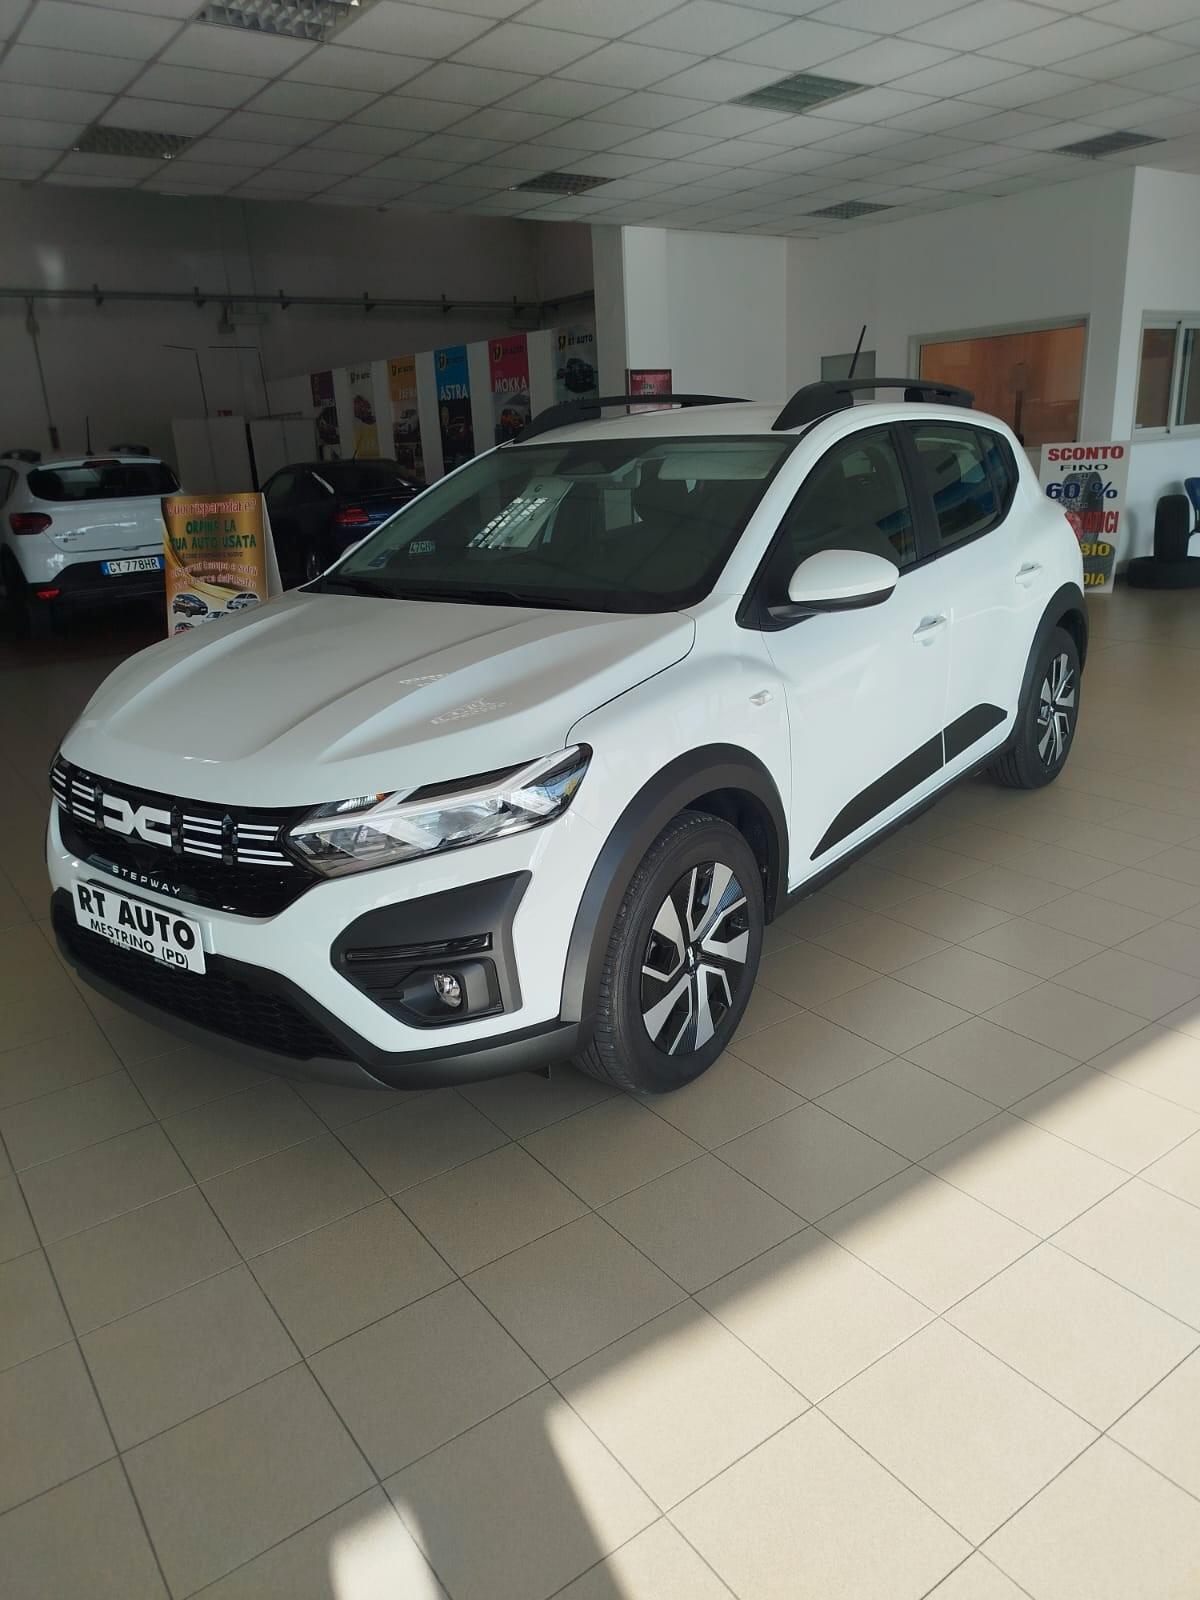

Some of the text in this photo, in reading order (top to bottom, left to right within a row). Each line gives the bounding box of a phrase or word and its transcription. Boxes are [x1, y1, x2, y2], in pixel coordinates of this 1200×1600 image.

[577, 333, 593, 345] AUTO
[495, 376, 528, 392] MOKKA
[440, 384, 469, 401] ASTRA
[1048, 445, 1124, 462] SCONTO
[1060, 464, 1108, 472] FINO
[1046, 481, 1118, 500] 60 %
[224, 519, 237, 532] LA
[192, 536, 219, 549] AUTO
[223, 534, 257, 548] USATA
[1081, 543, 1110, 557] BIO
[126, 558, 158, 571] 778HR
[112, 865, 181, 895] STEPWAY
[77, 884, 195, 951] RT AUTO
[90, 918, 189, 970] MESTRINO (PD)
